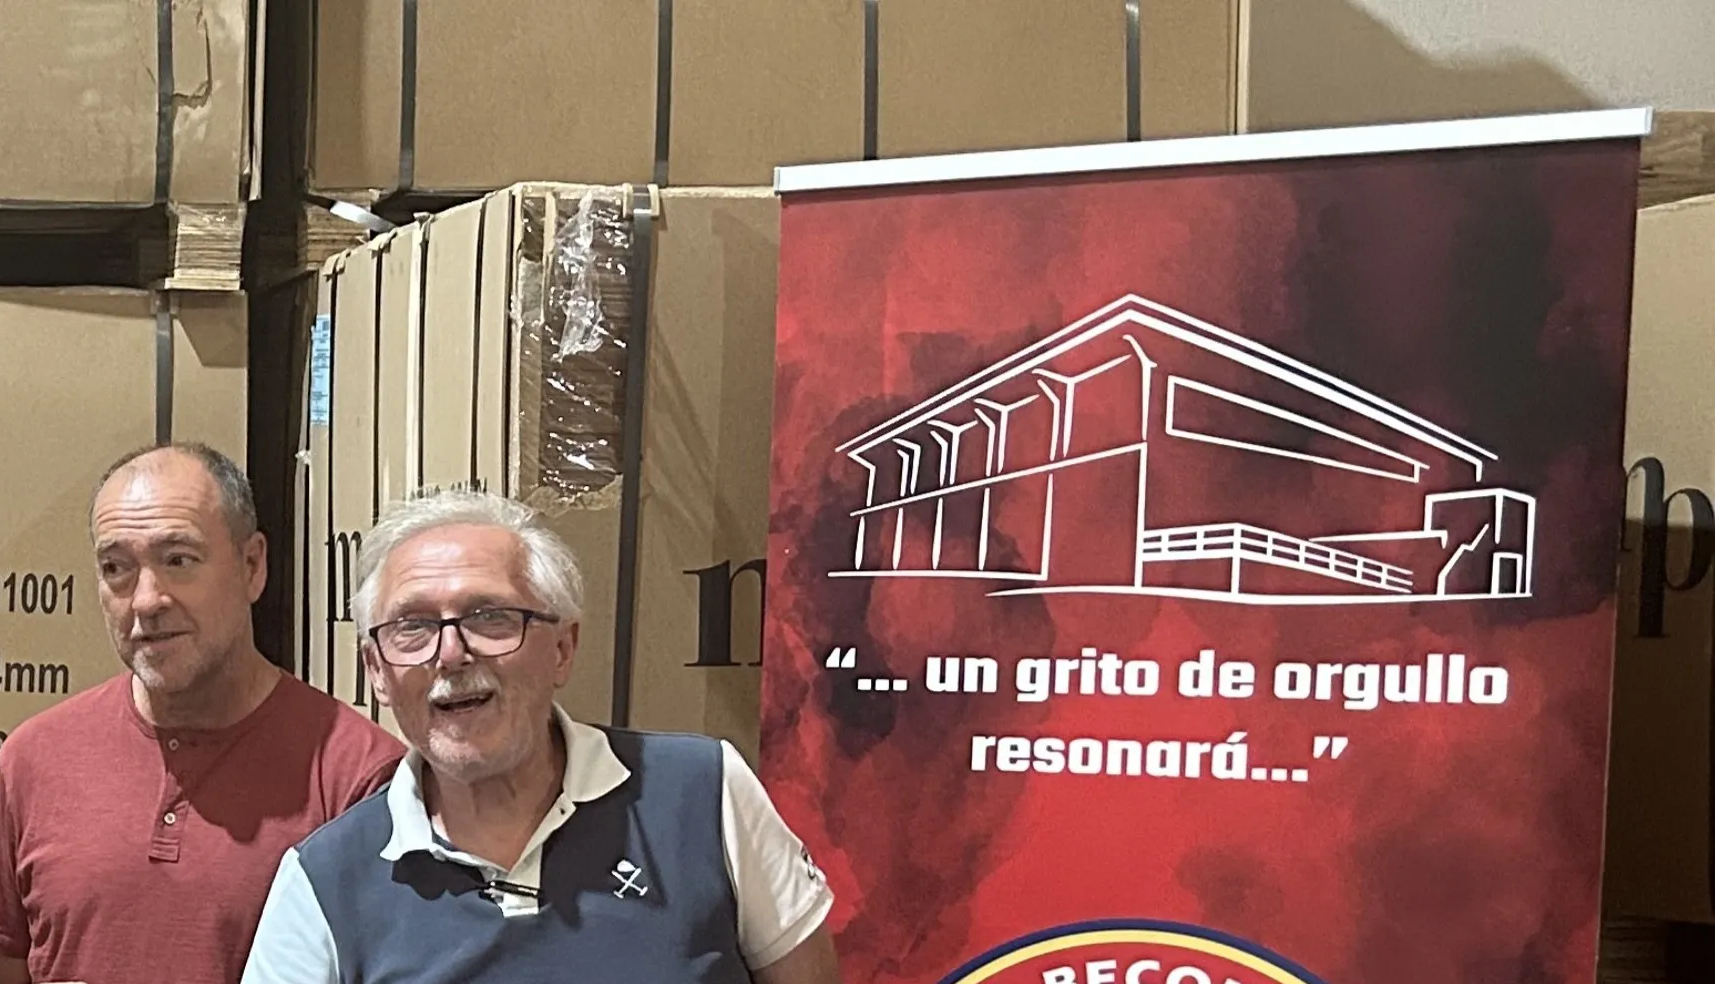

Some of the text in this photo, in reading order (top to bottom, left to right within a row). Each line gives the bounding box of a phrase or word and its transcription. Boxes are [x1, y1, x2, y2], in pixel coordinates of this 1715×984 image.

[926, 657, 998, 693] un
[1016, 647, 1160, 702] grito
[1178, 649, 1255, 698] de
[1273, 653, 1509, 710] orgullo
